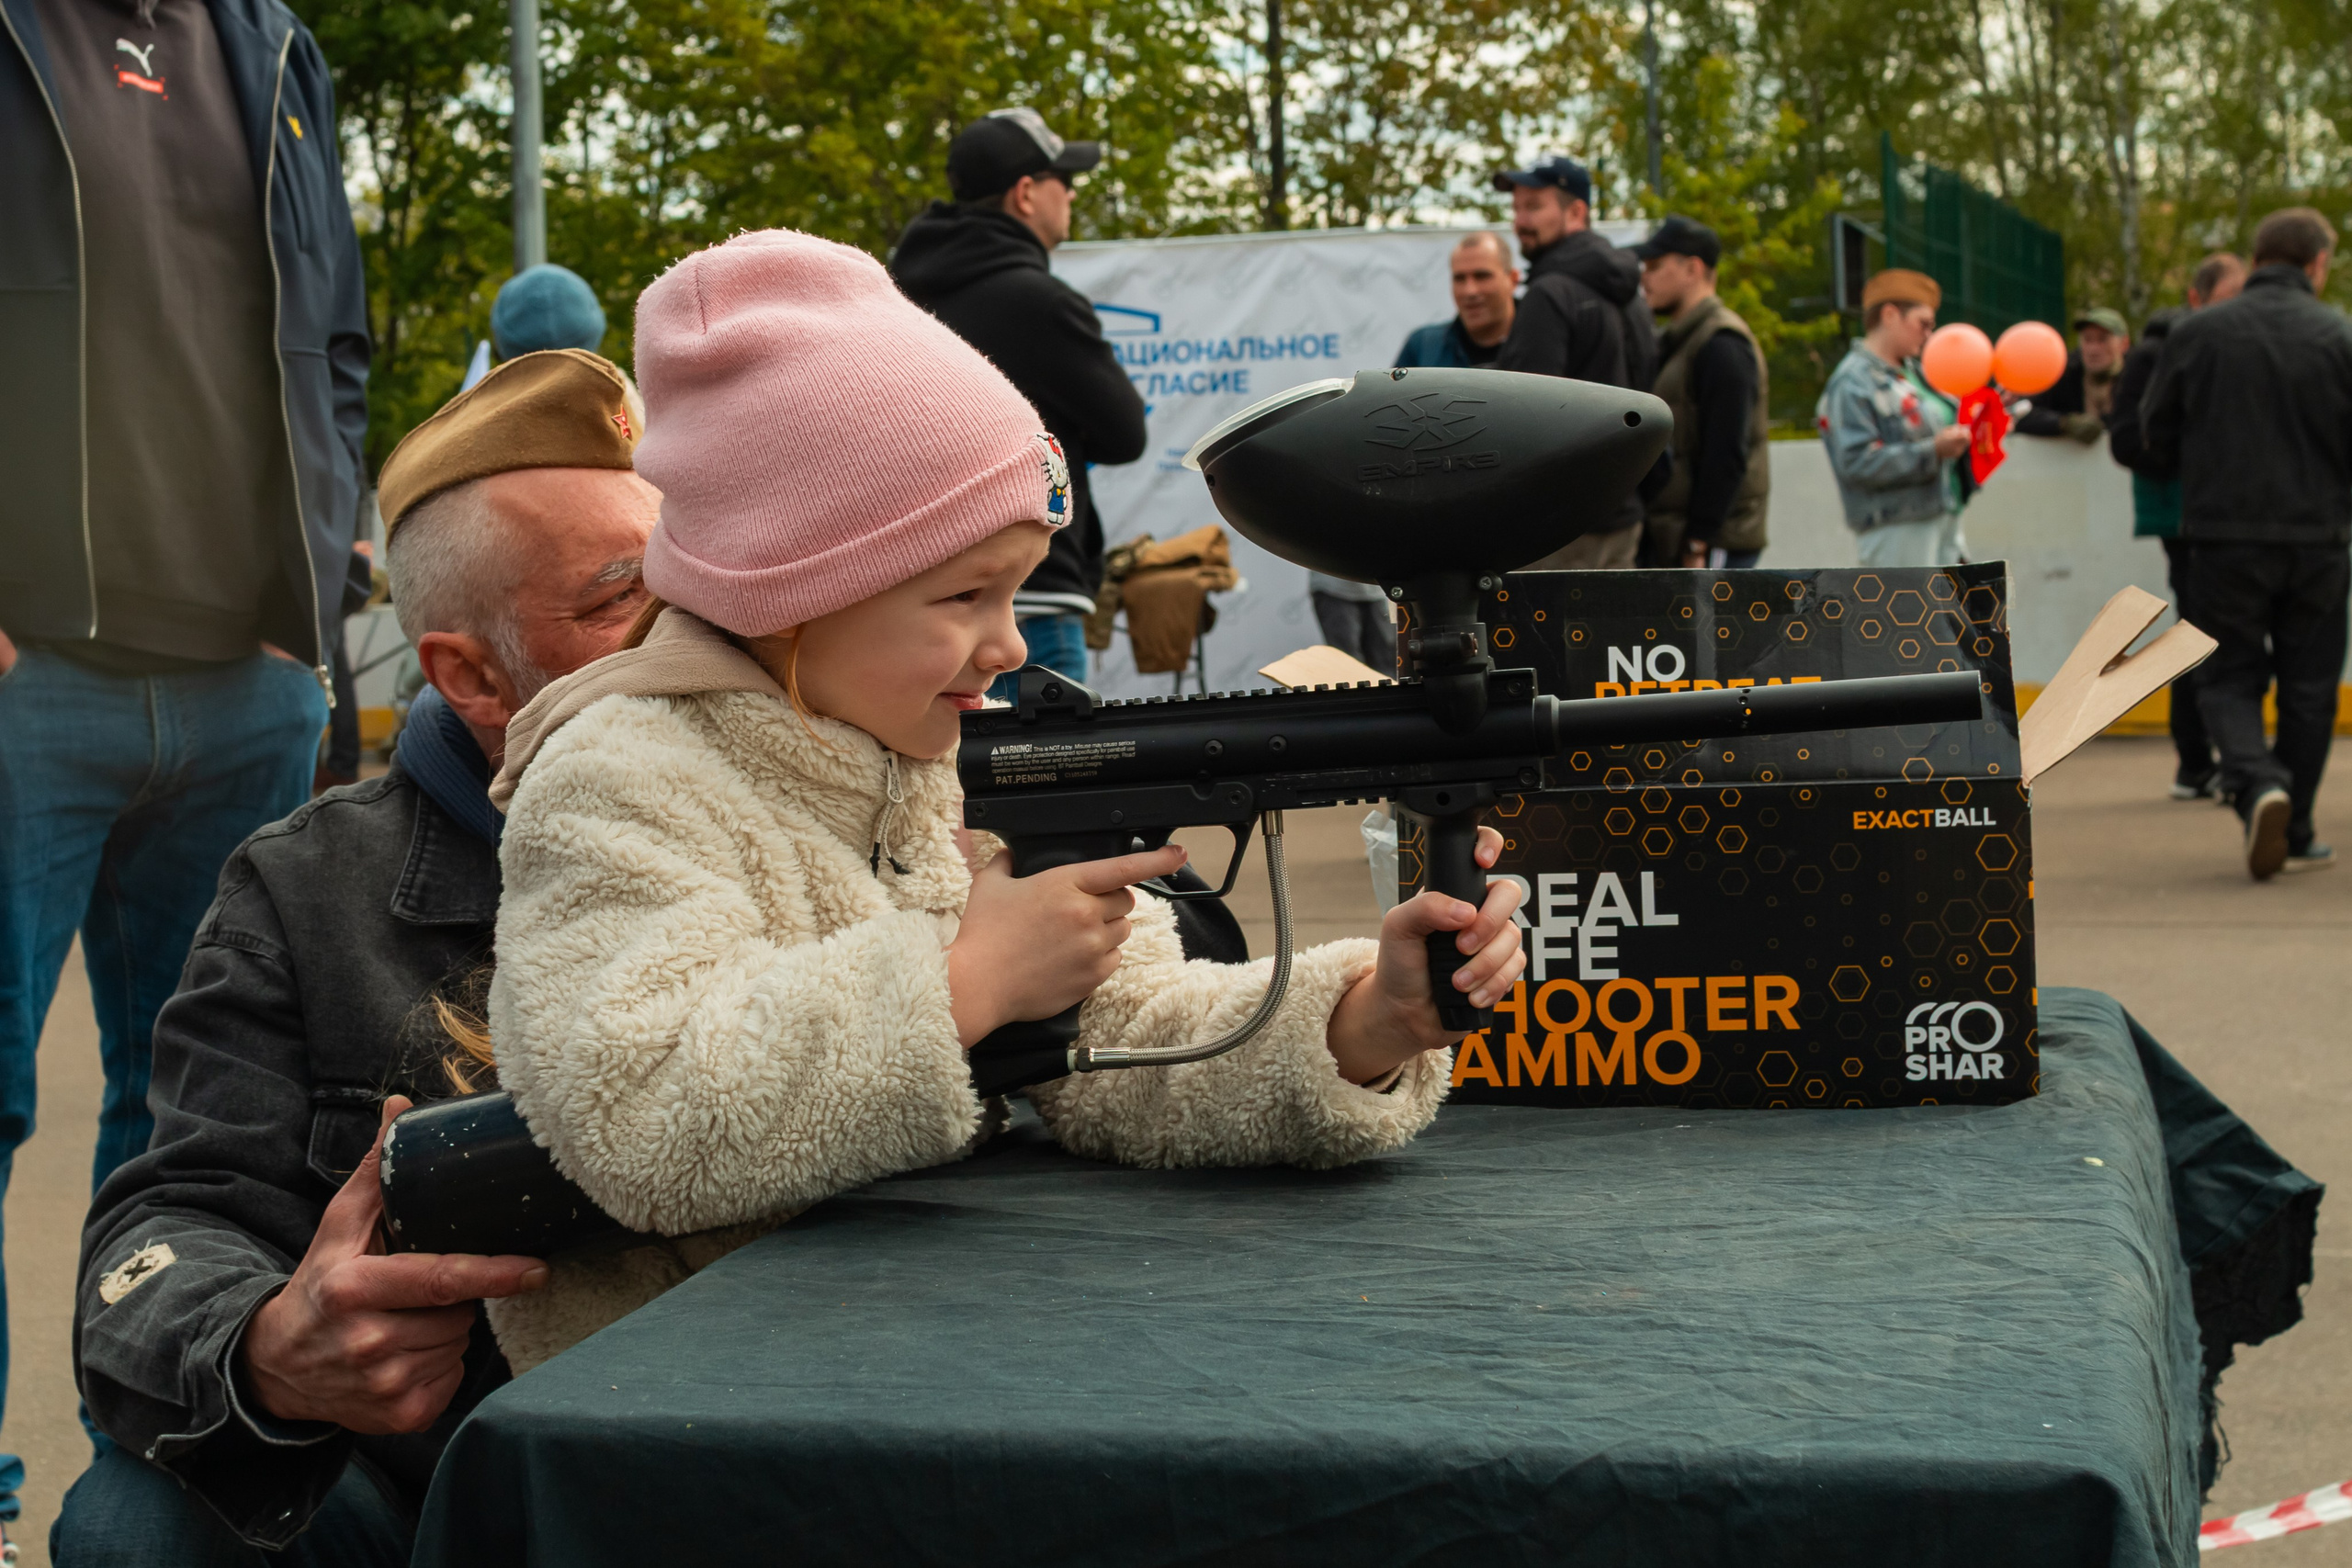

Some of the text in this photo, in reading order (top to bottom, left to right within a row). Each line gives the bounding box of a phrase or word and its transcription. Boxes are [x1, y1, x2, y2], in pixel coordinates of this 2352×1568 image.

[1112, 333, 1340, 366] АЦИОНАЛЬНОЕ
[1129, 370, 1250, 396] ЛАСИЕ
[1358, 450, 1501, 481] EMPIRE
[1607, 644, 1686, 682] NO
[999, 743, 1033, 754] WARNING!
[1853, 807, 1996, 829] EXACTBALL
[1478, 975, 1802, 1034] HOOTER
[1905, 1000, 2005, 1053] PRO
[1451, 1030, 1702, 1088] AMMO
[1905, 1053, 2005, 1081] SHAR
